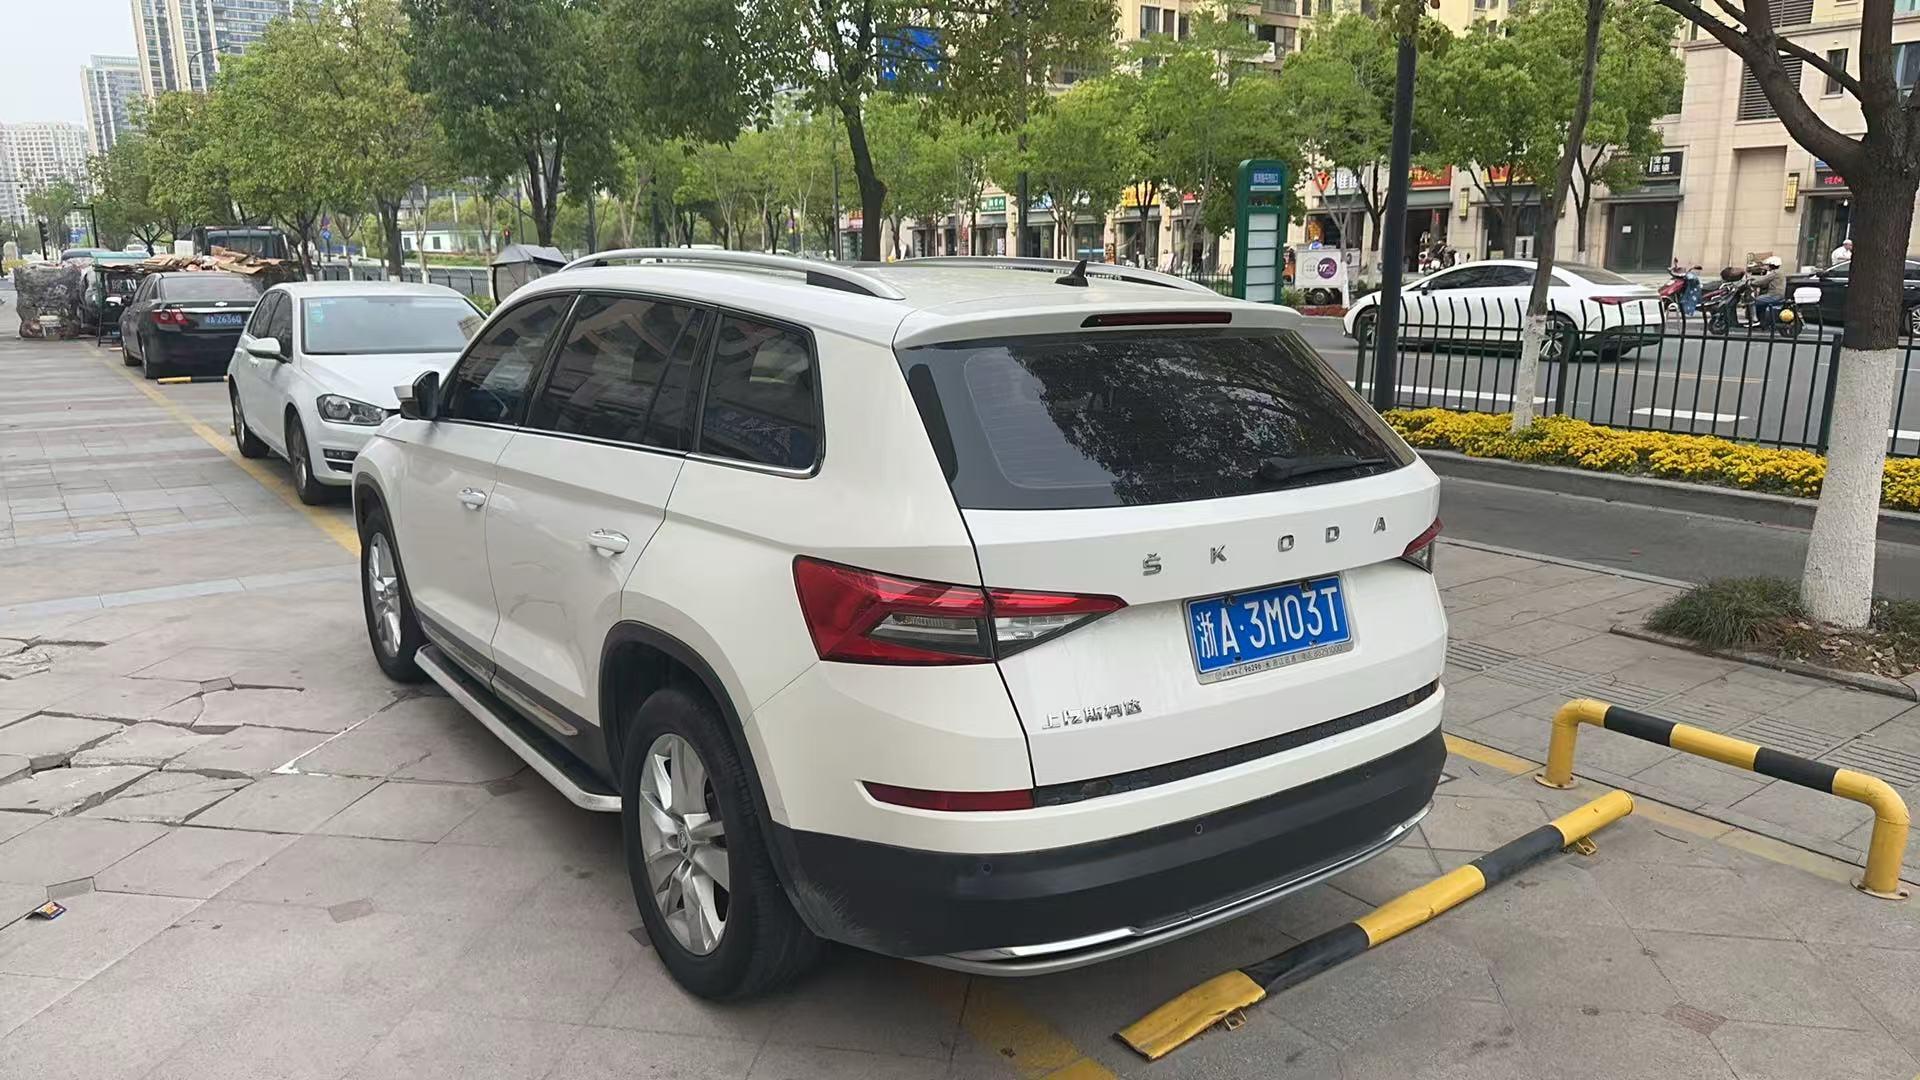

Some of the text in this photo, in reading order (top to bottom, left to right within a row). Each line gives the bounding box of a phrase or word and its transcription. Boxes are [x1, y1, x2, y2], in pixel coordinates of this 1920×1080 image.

[1142, 516, 1387, 576] ŠKODA
[1196, 586, 1338, 659] 浙A·3M03T
[1042, 699, 1143, 730] 上汽斯柯达
